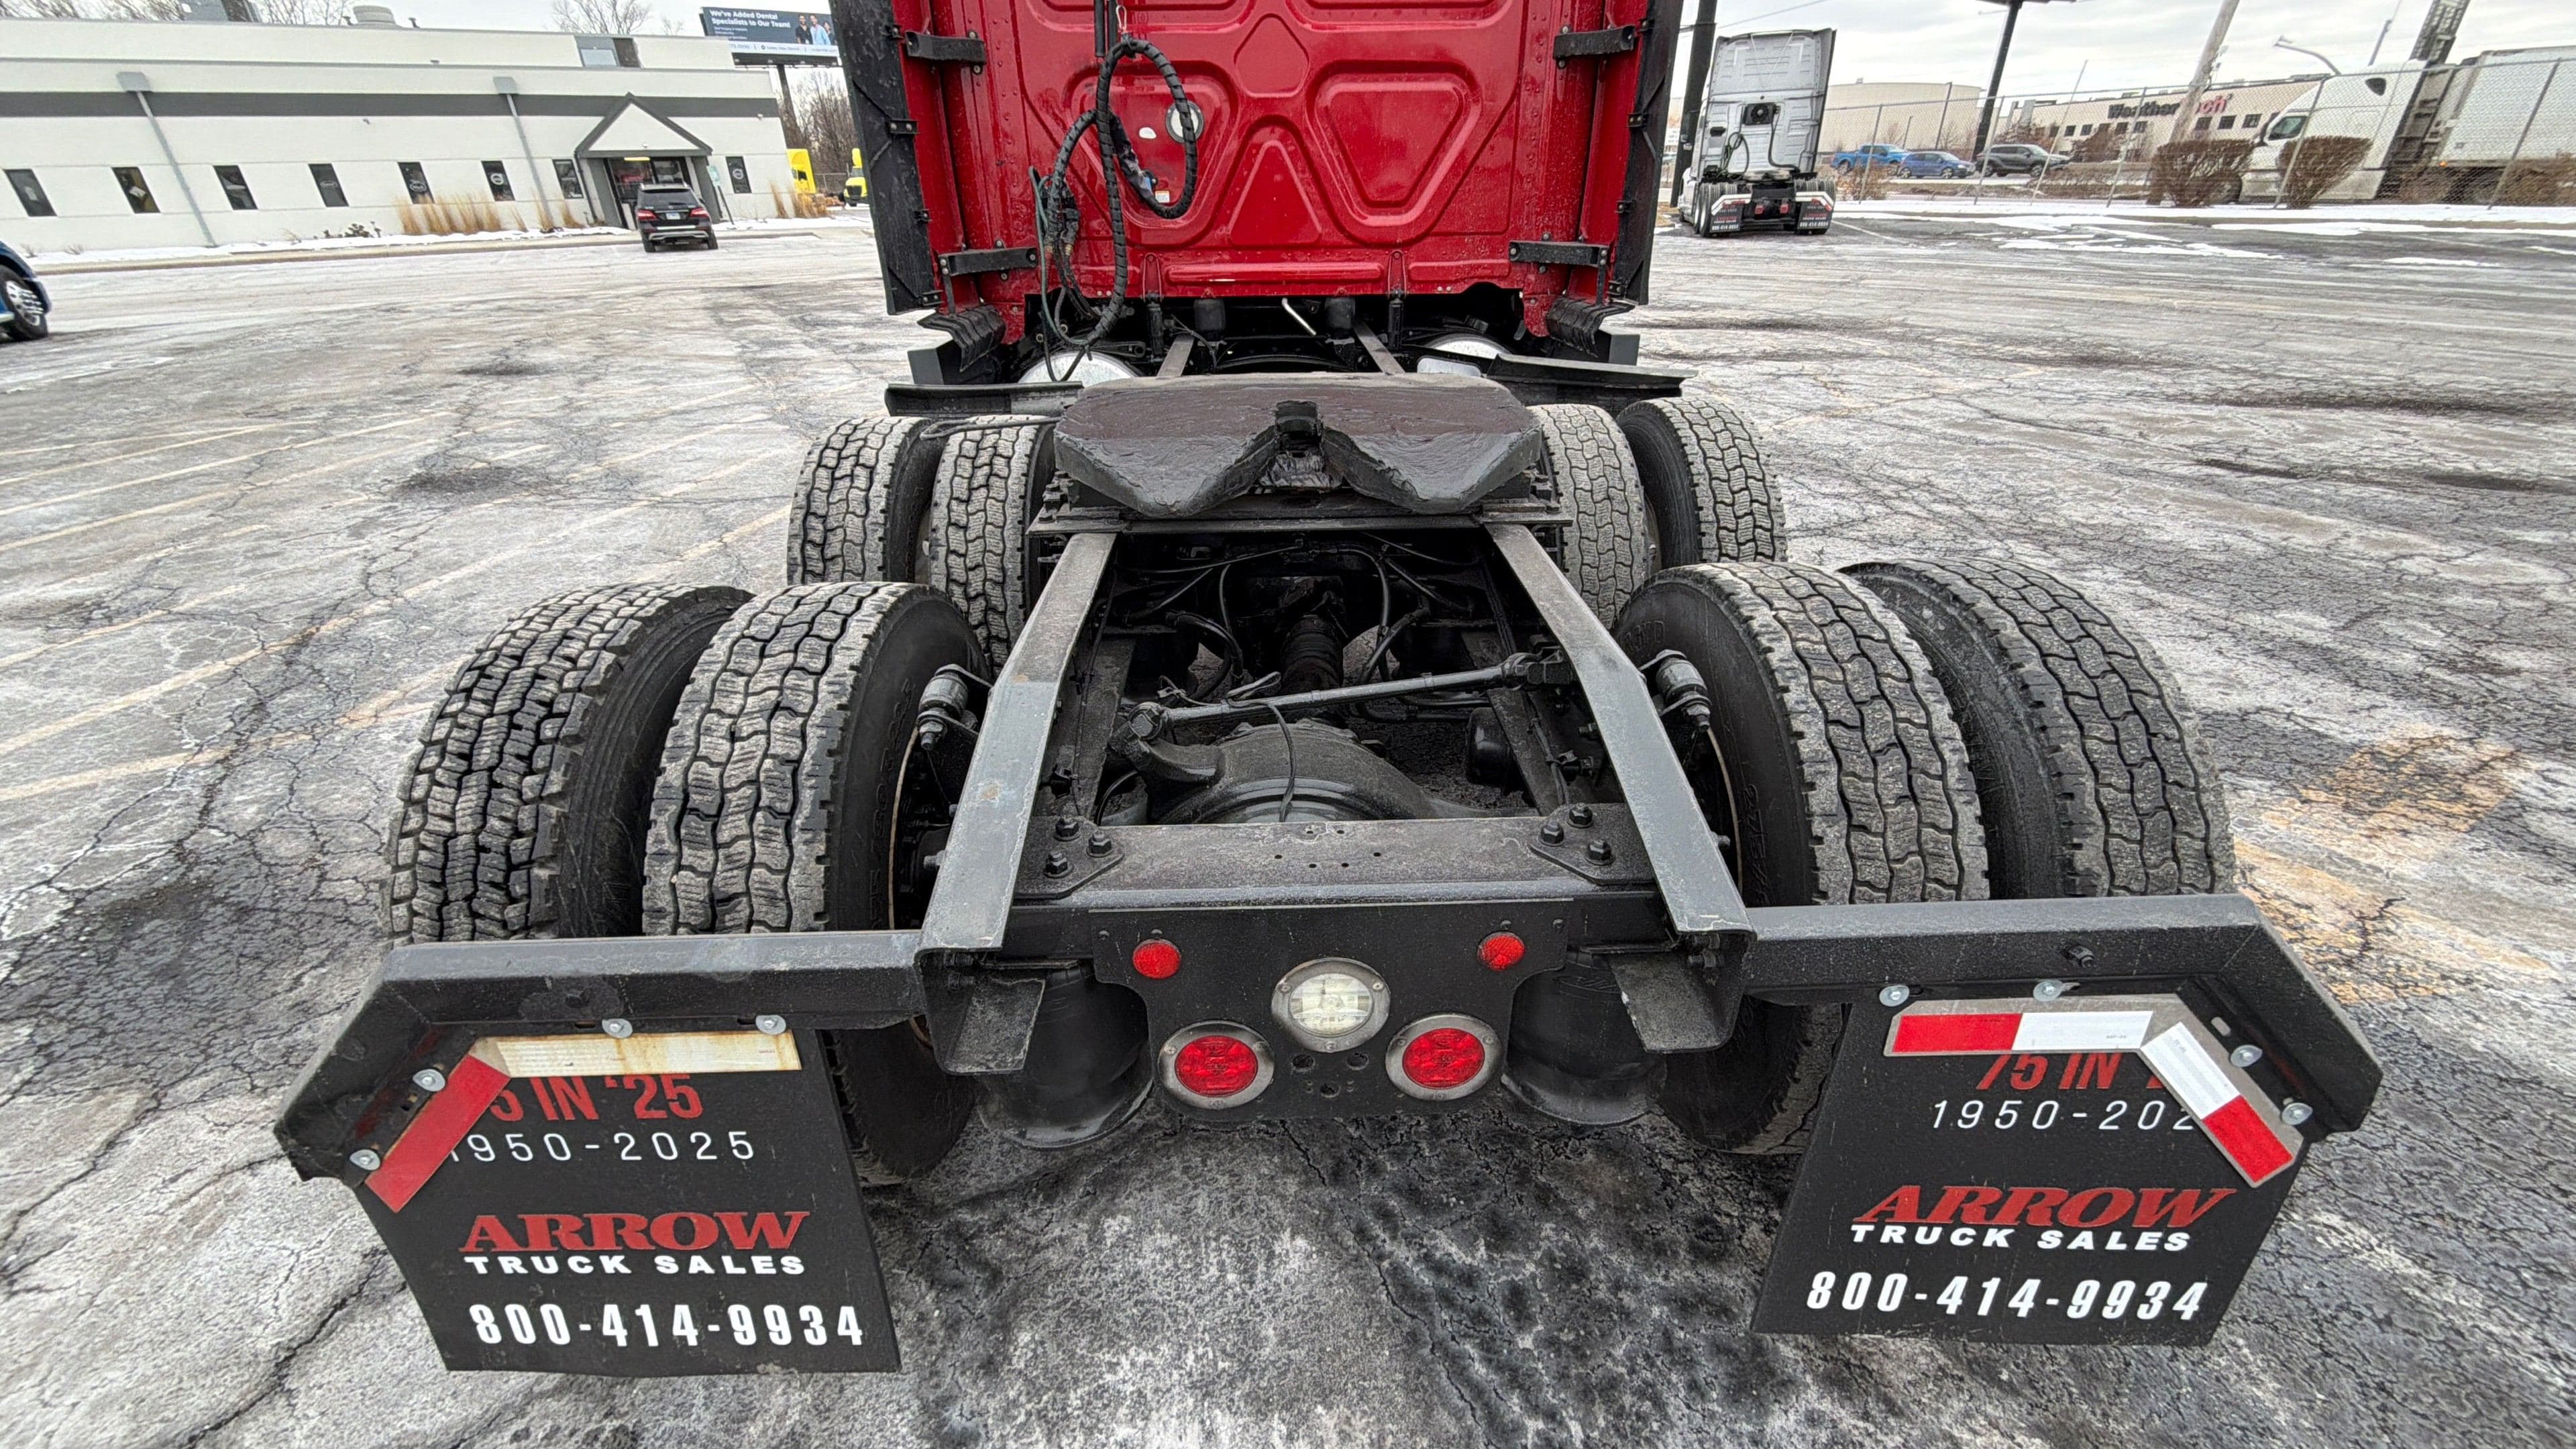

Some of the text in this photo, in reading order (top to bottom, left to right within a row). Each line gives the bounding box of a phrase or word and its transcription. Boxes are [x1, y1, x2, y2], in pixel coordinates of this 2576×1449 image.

[710, 9, 731, 17] We've
[711, 18, 748, 26] Specialists
[2107, 95, 2227, 119] Weatherch
[2058, 1053, 2122, 1089] IN
[529, 1075, 599, 1122] IN
[1852, 1186, 2238, 1229] ARROW
[458, 1211, 811, 1253] ARROW
[1850, 1224, 2190, 1252] TRUCK SALES
[464, 1255, 806, 1275] TRUCK SALES
[1806, 1271, 2208, 1321] 800-414-9934
[469, 1303, 864, 1347] 800-414-9934
